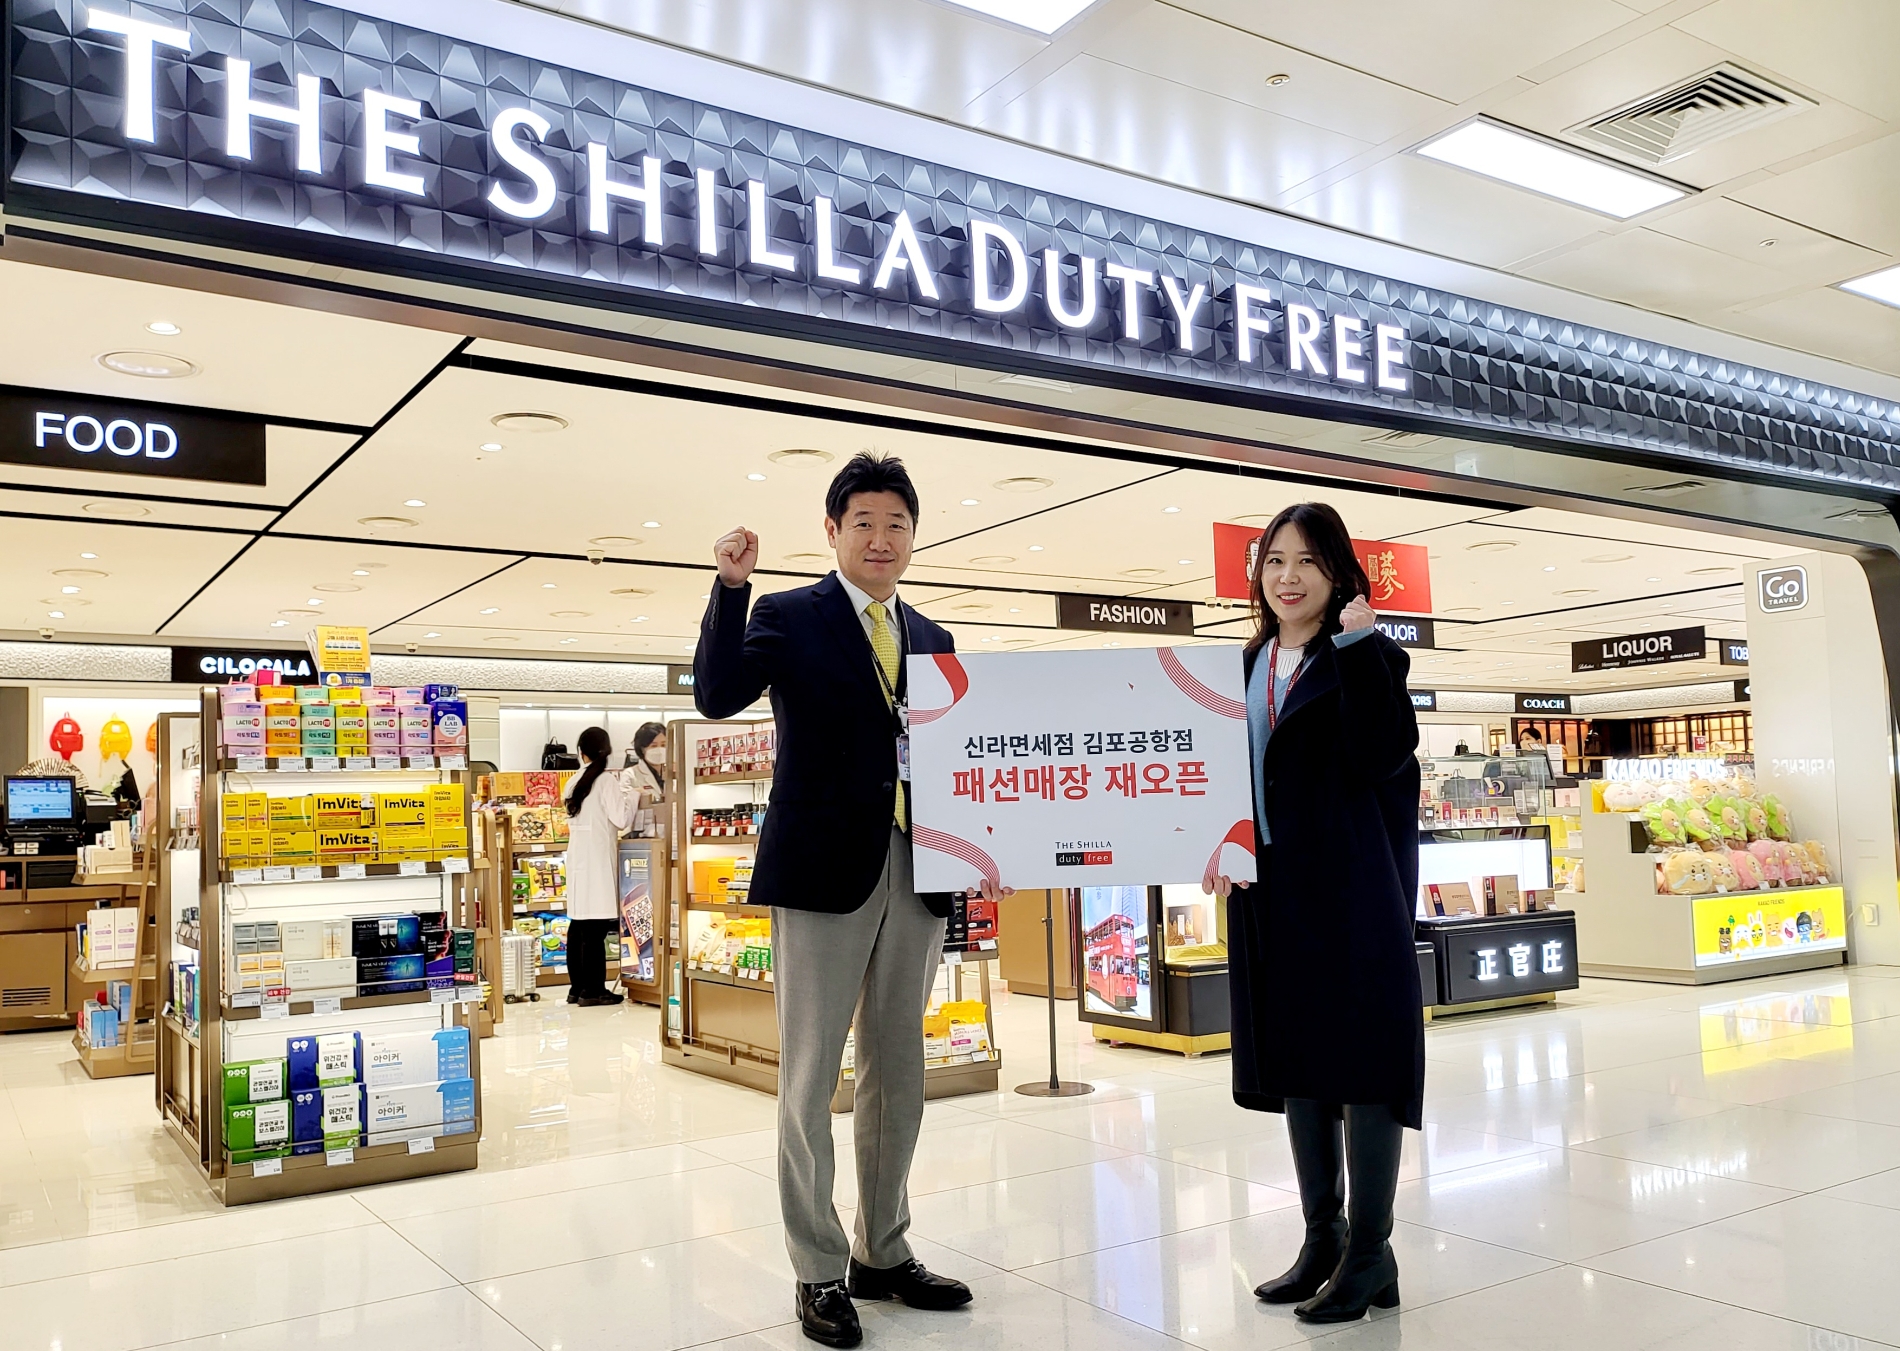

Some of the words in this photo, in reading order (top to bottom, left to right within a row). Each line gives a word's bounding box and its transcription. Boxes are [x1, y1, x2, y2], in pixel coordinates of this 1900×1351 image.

[87, 8, 427, 197] THE
[487, 106, 940, 300] SHILLA
[970, 218, 1206, 351] DUTY
[1235, 282, 1408, 391] FREE
[35, 411, 179, 460] FOOD
[1766, 576, 1800, 598] Go
[1768, 596, 1799, 606] TRAVEL
[1090, 602, 1167, 625] FASHION
[1602, 635, 1672, 659] LIQUOR
[199, 656, 311, 677] CILOCALA
[1523, 698, 1565, 709] COACH
[964, 732, 1074, 758] 신라면세점
[1083, 728, 1193, 755] 김포공항점
[1606, 758, 1661, 780] KAKAO
[1661, 758, 1725, 780] FRIENDS
[953, 763, 1092, 803] 패션매장
[1104, 760, 1209, 800] 재오픈
[416, 813, 425, 821] C
[320, 833, 370, 845] I'mVita
[1055, 841, 1075, 850] THE
[1077, 840, 1112, 849] SHILLA
[1059, 854, 1081, 865] duty
[1088, 853, 1109, 863] free
[1476, 939, 1565, 981] 正官庄
[373, 1053, 400, 1063] 아이커
[378, 1105, 404, 1116] 아이커
